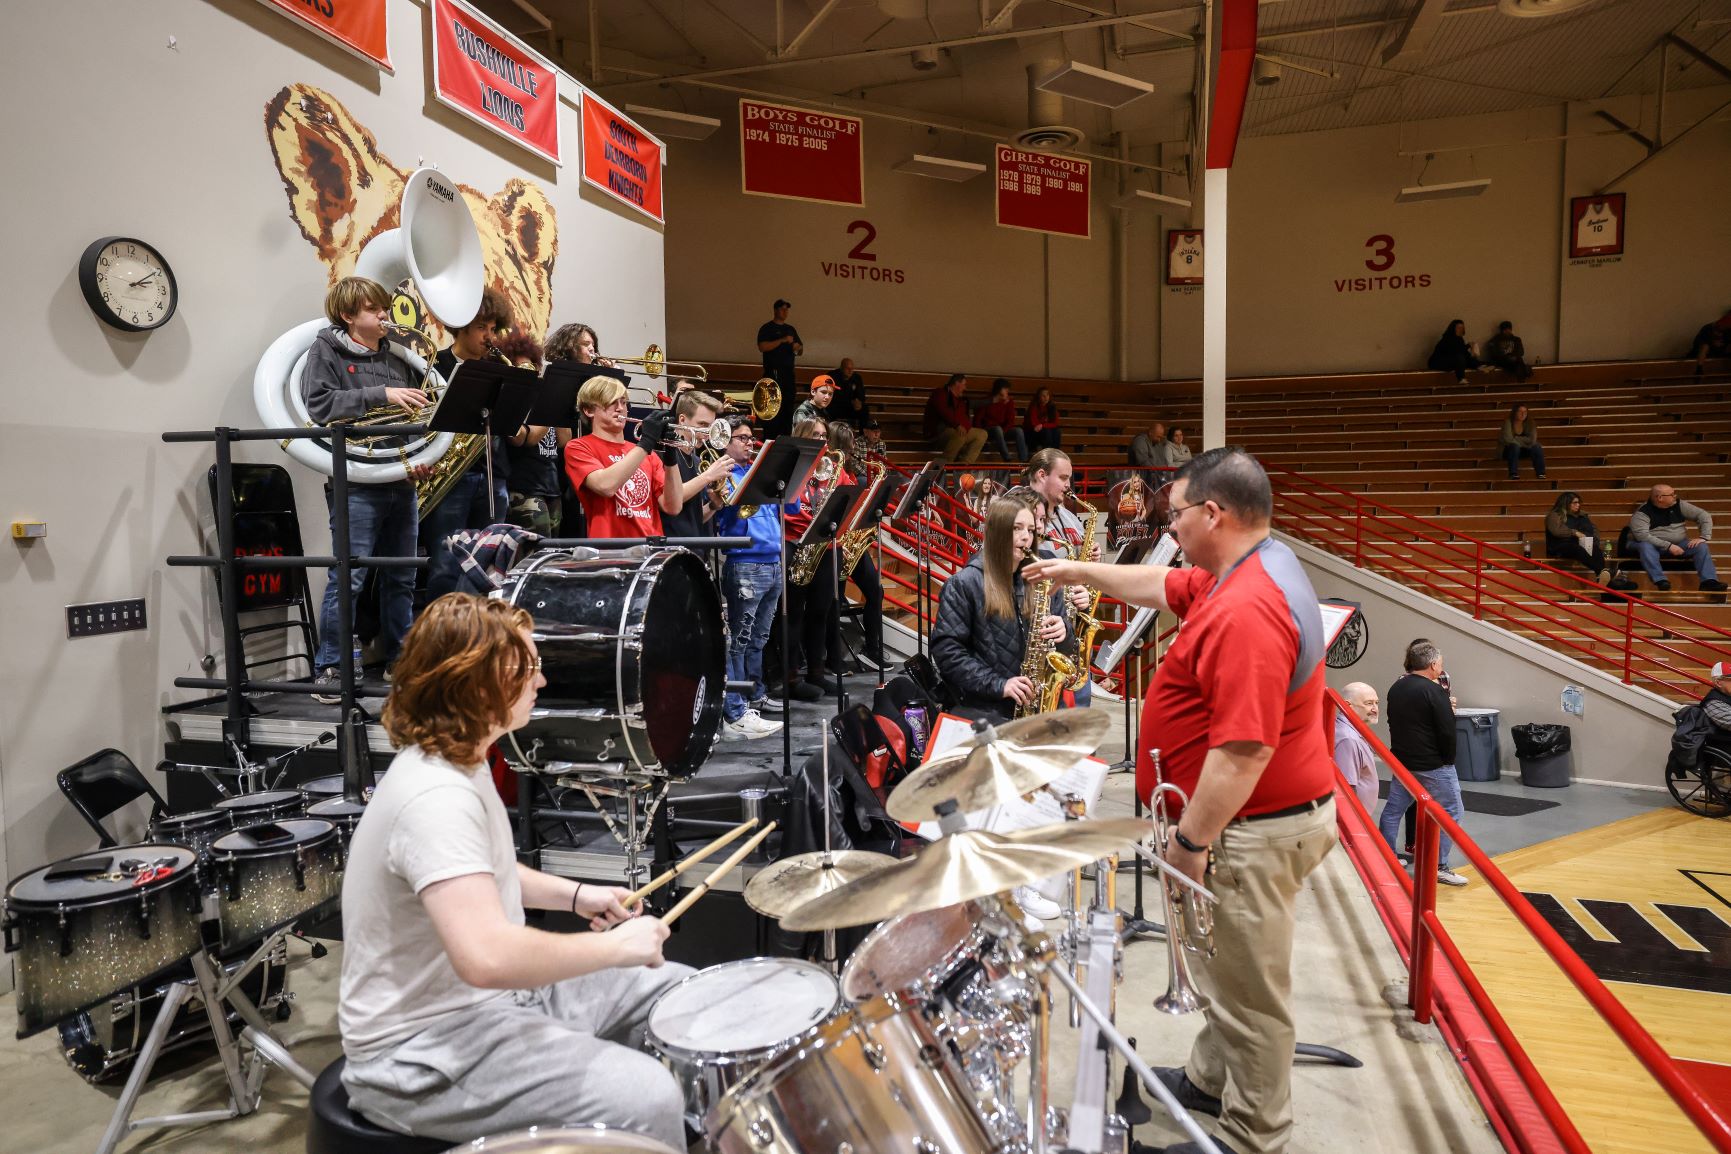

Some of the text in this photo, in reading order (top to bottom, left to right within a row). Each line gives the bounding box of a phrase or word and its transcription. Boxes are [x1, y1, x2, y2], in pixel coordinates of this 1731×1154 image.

[453, 19, 539, 100] RUSHVILLE
[479, 80, 526, 132] LIONS
[746, 105, 857, 135] BOYS GOLF
[609, 119, 638, 154] SOUTH
[769, 121, 837, 139] STATE FINALIST
[746, 128, 828, 151] 1974 1975 2005
[604, 140, 648, 184] DEARBORN
[1000, 149, 1087, 176] GIRLS GOLF
[1018, 163, 1071, 179] STATE FINALIST
[608, 168, 644, 207] KNIGHTS
[1000, 169, 1083, 193] 1978 1979 1980 1981
[432, 181, 454, 202] YAMAHA
[1593, 225, 1603, 233] 10
[127, 244, 136, 255] 12
[846, 220, 877, 262] 2
[111, 245, 118, 256] 11
[145, 254, 149, 263] 1
[1365, 234, 1395, 272] 3
[99, 256, 109, 267] 10
[1186, 255, 1193, 264] 8
[97, 272, 104, 283] 9
[156, 267, 162, 278] 2
[821, 261, 905, 284] VISITORS
[161, 285, 167, 296] 3
[1334, 274, 1432, 293] VISITORS
[103, 291, 109, 303] 8
[116, 307, 122, 317] 7
[157, 301, 163, 311] 4
[132, 314, 139, 324] 6
[147, 313, 154, 322] 5
